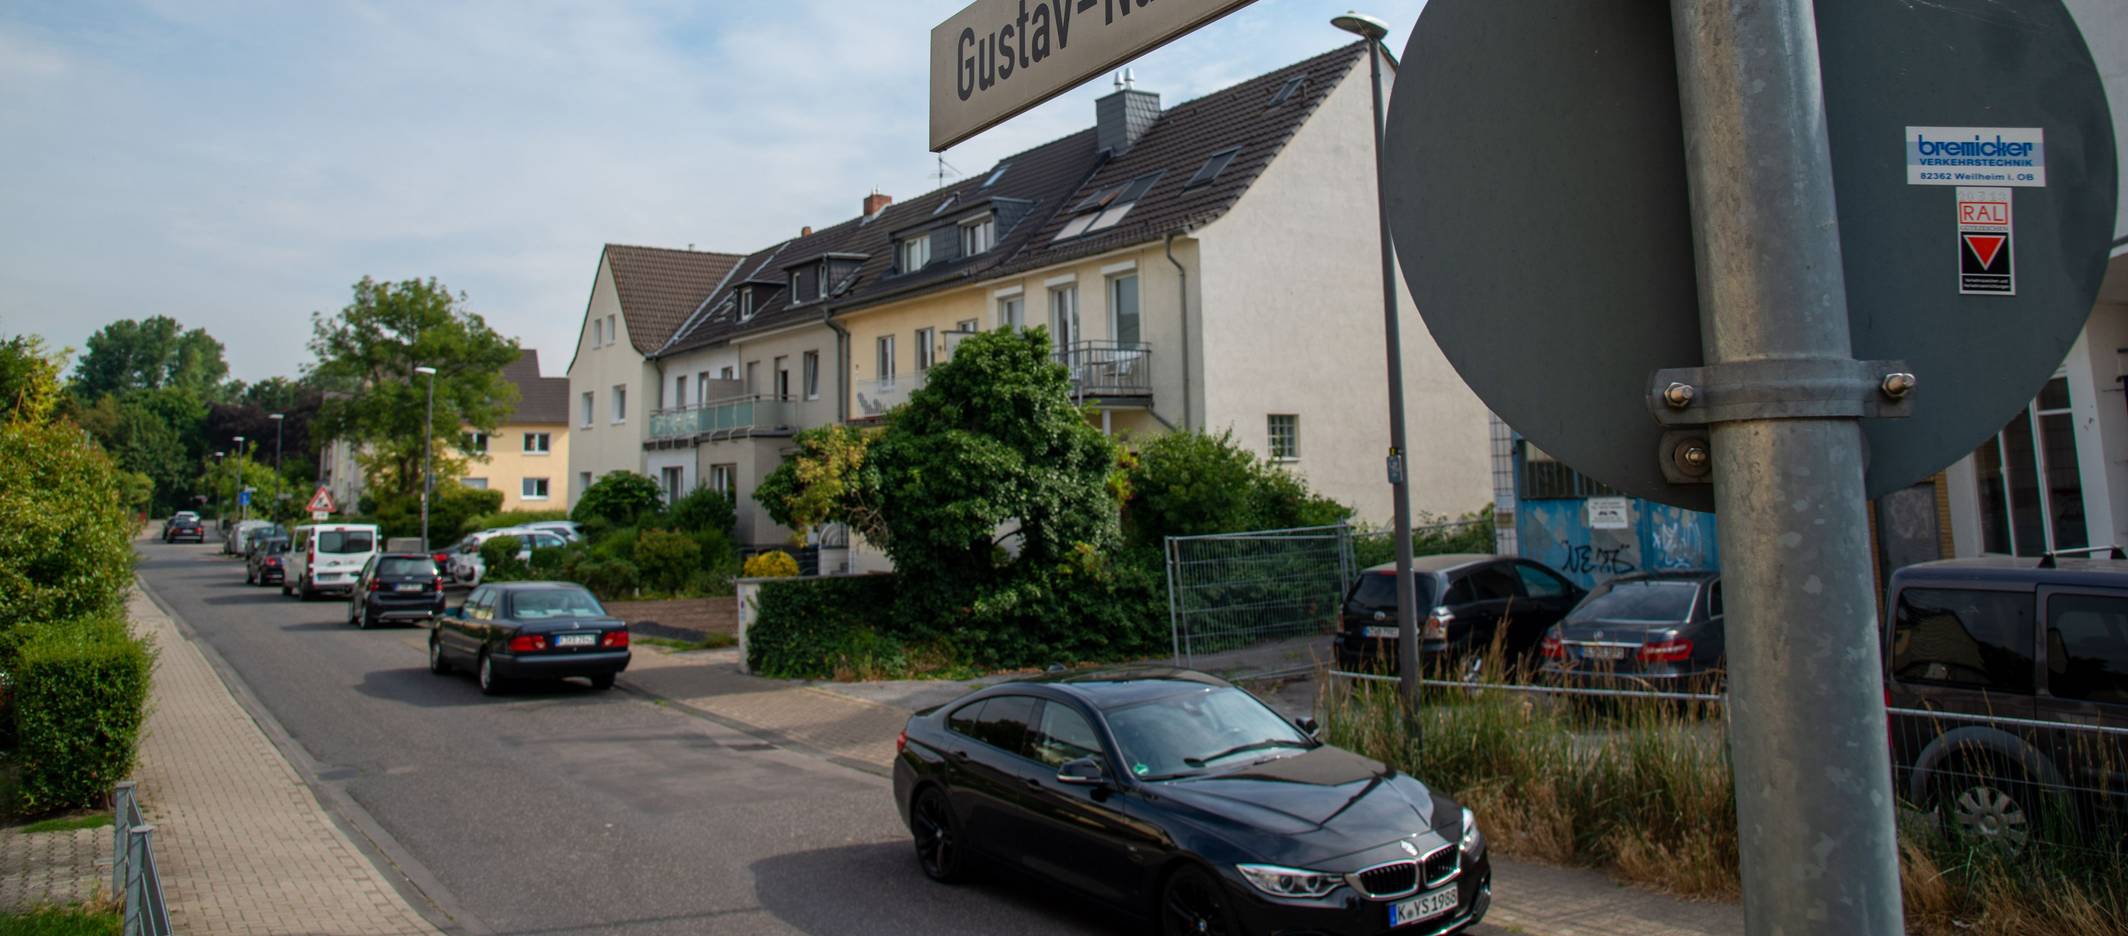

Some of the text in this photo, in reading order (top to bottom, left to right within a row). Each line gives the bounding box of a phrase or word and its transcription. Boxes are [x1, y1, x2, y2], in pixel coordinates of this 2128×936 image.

[1918, 134, 2033, 157] bremicker
[1919, 158, 2033, 167] VERKEHRSTECHNIK
[1920, 172, 1952, 180] 82362
[1955, 173, 2005, 181] Weilheim
[1963, 205, 2004, 222] RAL
